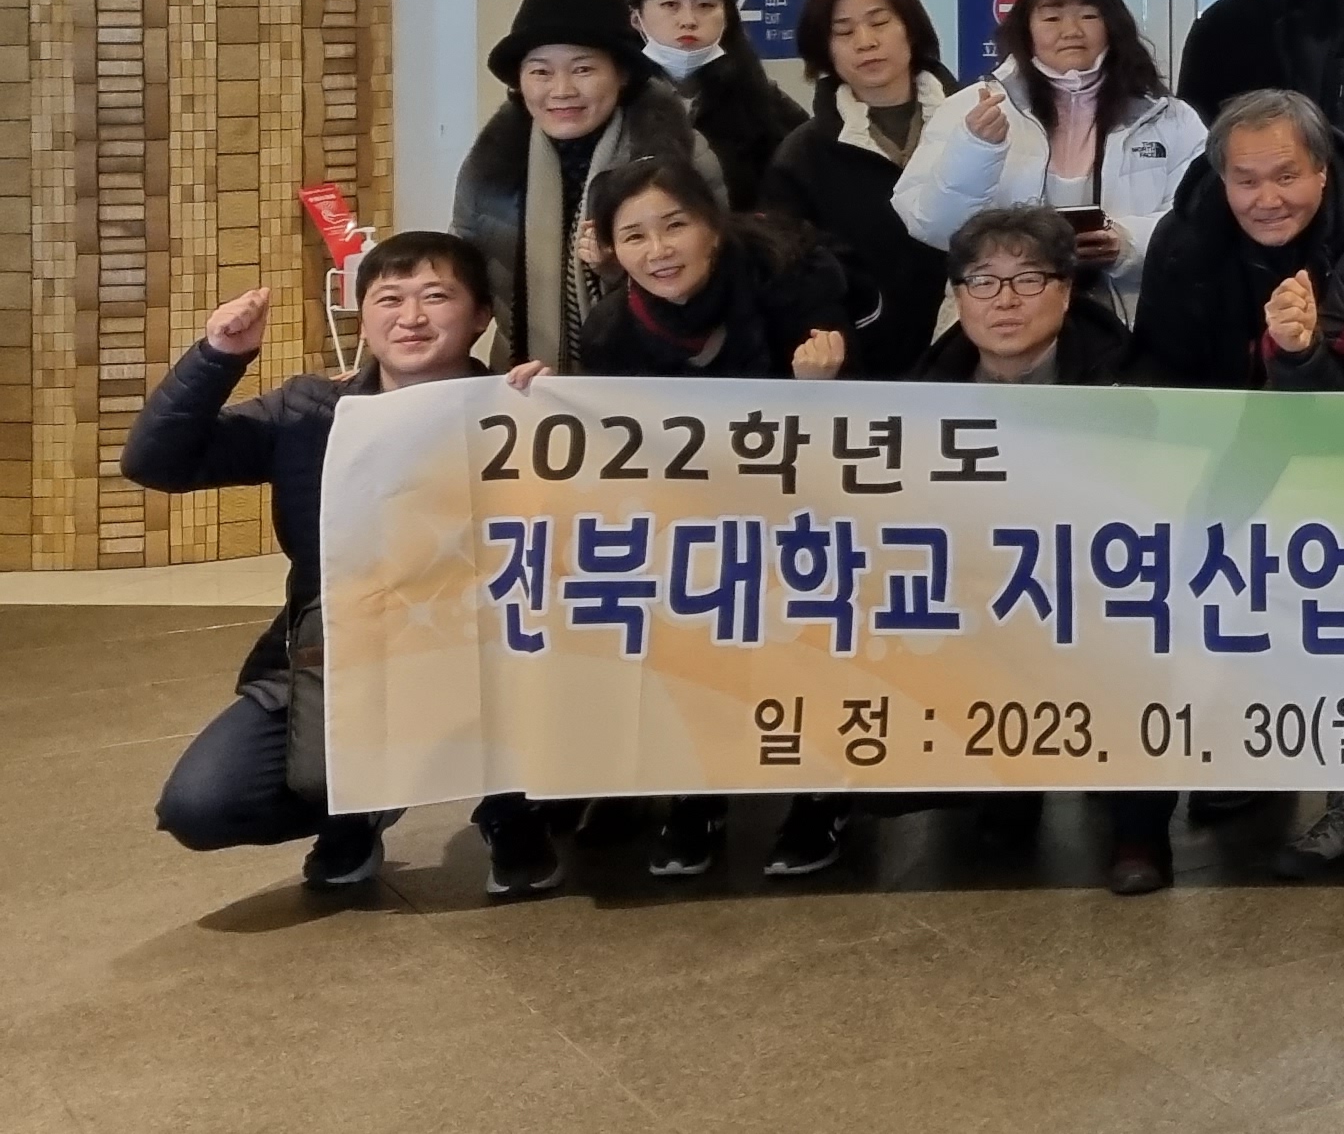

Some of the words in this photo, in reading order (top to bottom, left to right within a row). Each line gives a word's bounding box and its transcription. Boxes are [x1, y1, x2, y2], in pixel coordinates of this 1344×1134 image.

[487, 512, 961, 656] 전북대학교
[965, 700, 1109, 763] 2023.
[1140, 702, 1212, 764] 01.
